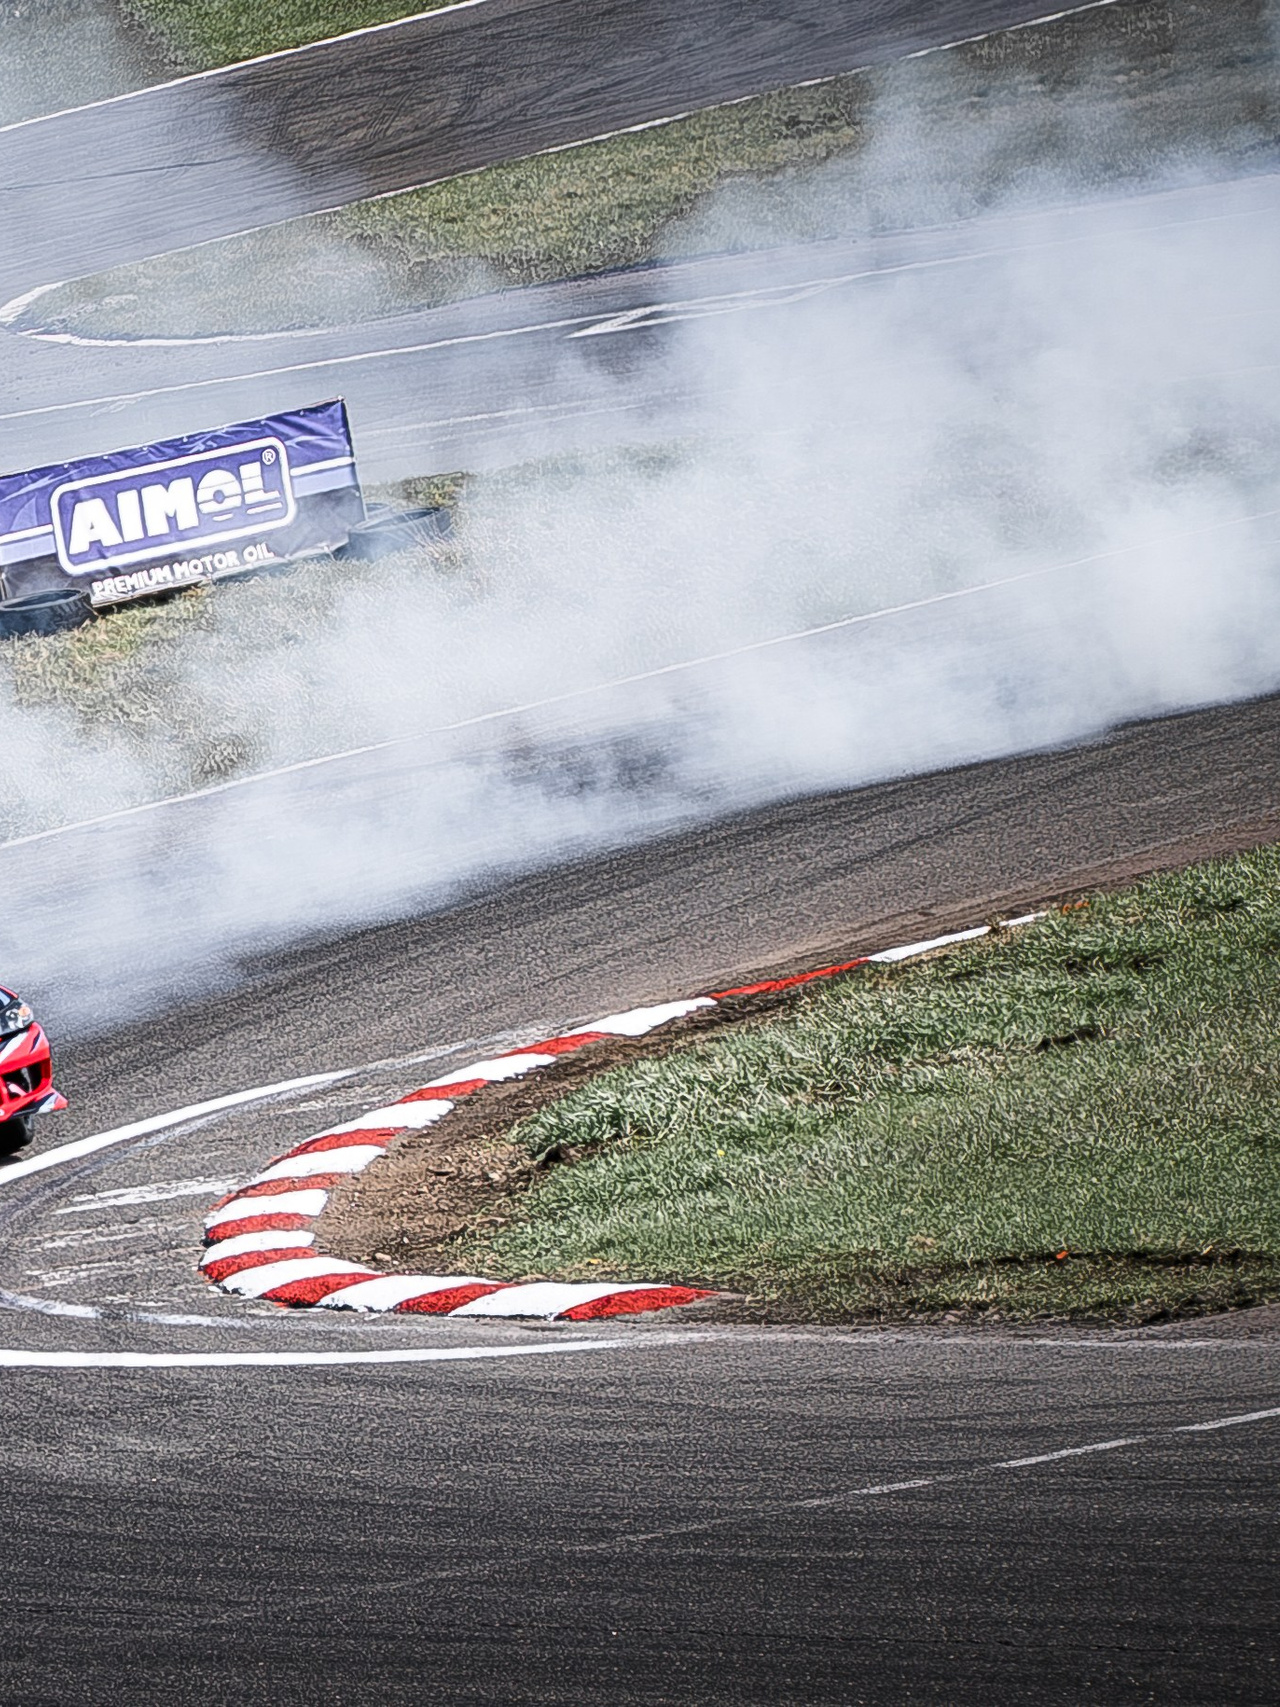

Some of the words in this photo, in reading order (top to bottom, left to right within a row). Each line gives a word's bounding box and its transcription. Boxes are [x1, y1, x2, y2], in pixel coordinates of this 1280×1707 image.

[69, 461, 283, 555] AIMOL
[91, 565, 172, 597] PREMIUM
[173, 549, 241, 580] MOTOR
[243, 542, 275, 563] OIL
